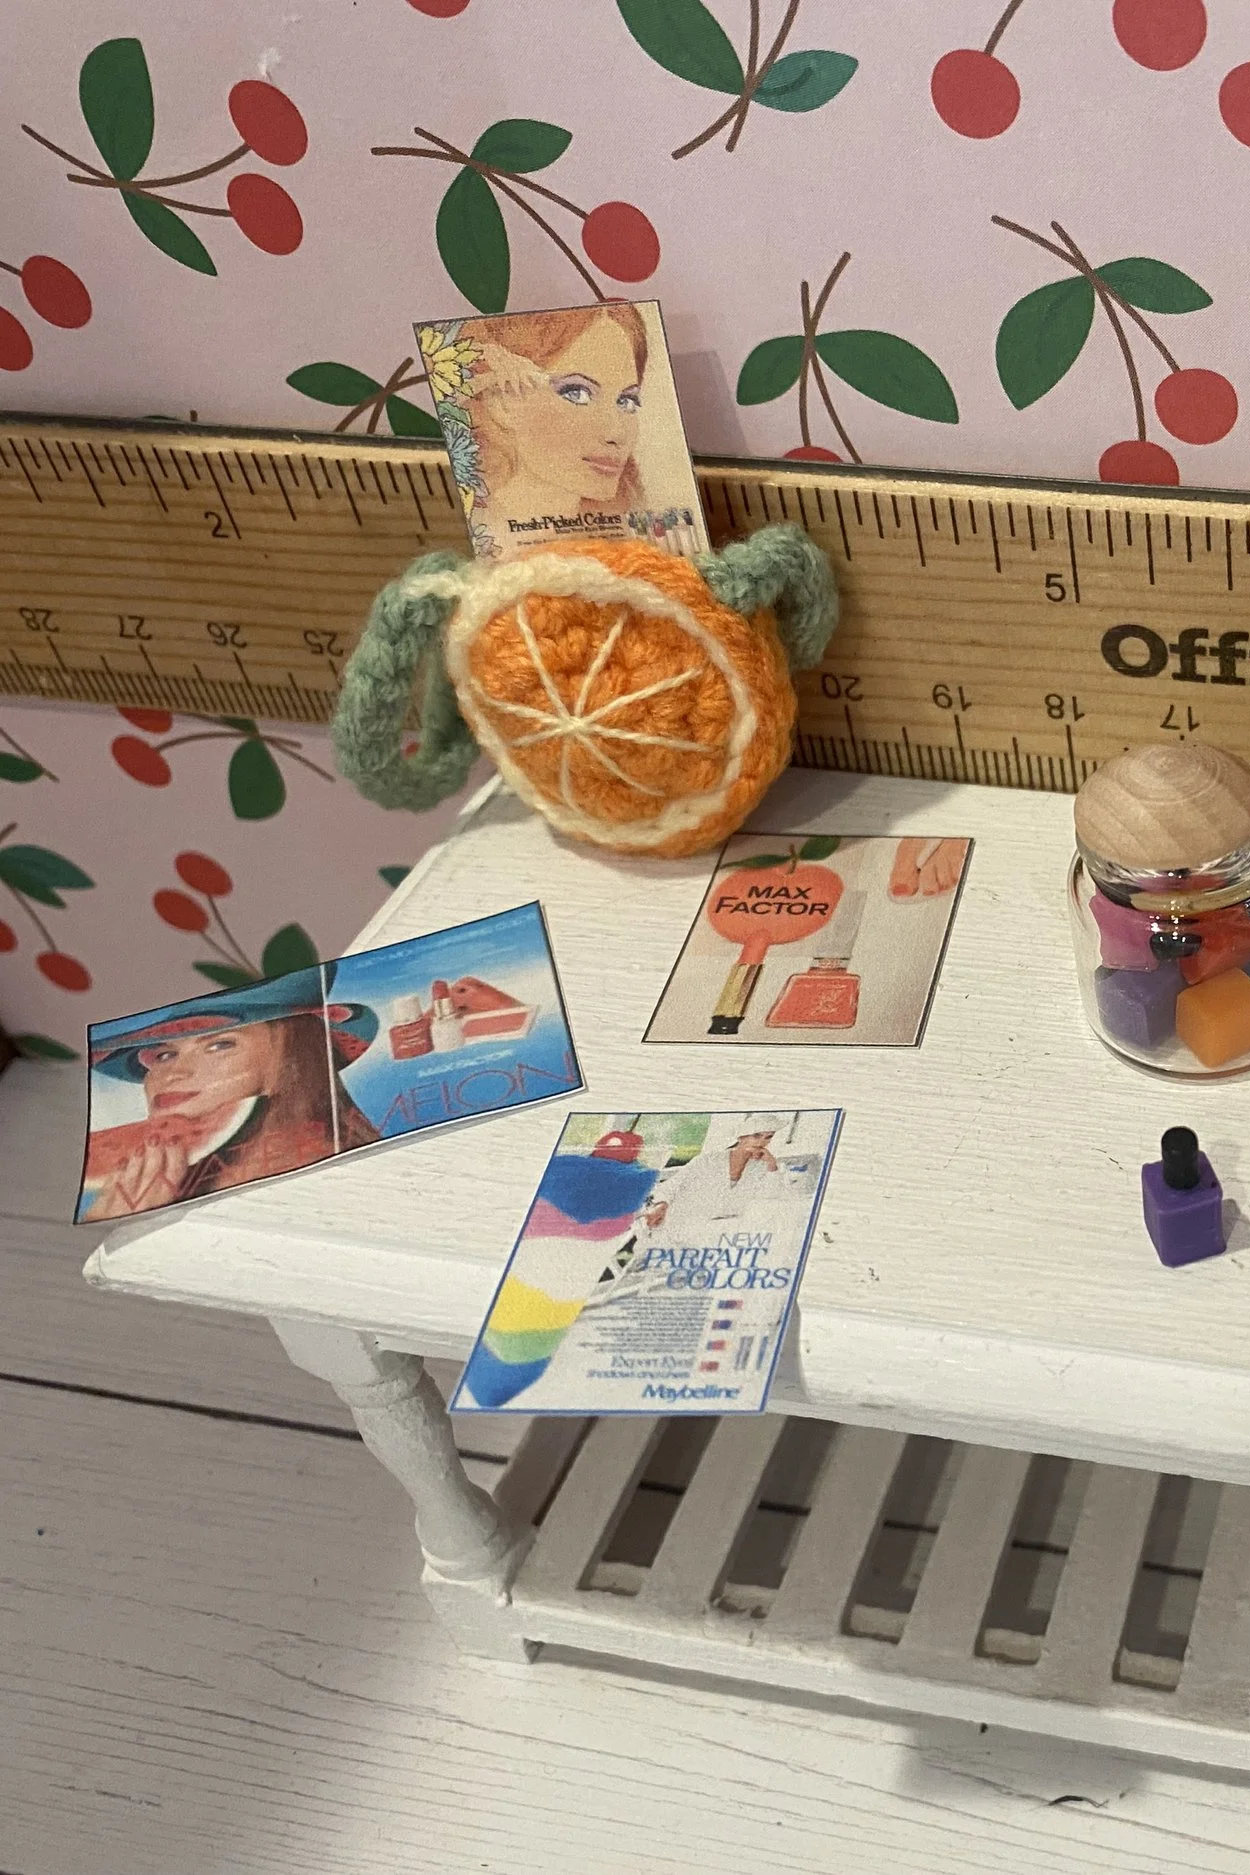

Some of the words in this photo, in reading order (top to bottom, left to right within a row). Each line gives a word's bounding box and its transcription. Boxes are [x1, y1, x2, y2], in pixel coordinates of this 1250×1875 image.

[204, 511, 230, 538] 2
[585, 511, 622, 526] Colors
[1045, 573, 1067, 603] 5
[19, 607, 60, 633] 28
[118, 615, 153, 642] 27
[207, 622, 248, 650] 26
[303, 629, 346, 657] 25
[820, 673, 864, 703] 20
[932, 683, 973, 712] 19
[1044, 693, 1085, 722] 18
[1160, 704, 1201, 733] 17
[715, 896, 829, 916] FACTOR
[748, 885, 812, 900] MAX
[643, 1247, 768, 1270] PARFAIT
[667, 1268, 792, 1290] COLORS
[642, 1384, 742, 1403] Maybelline
